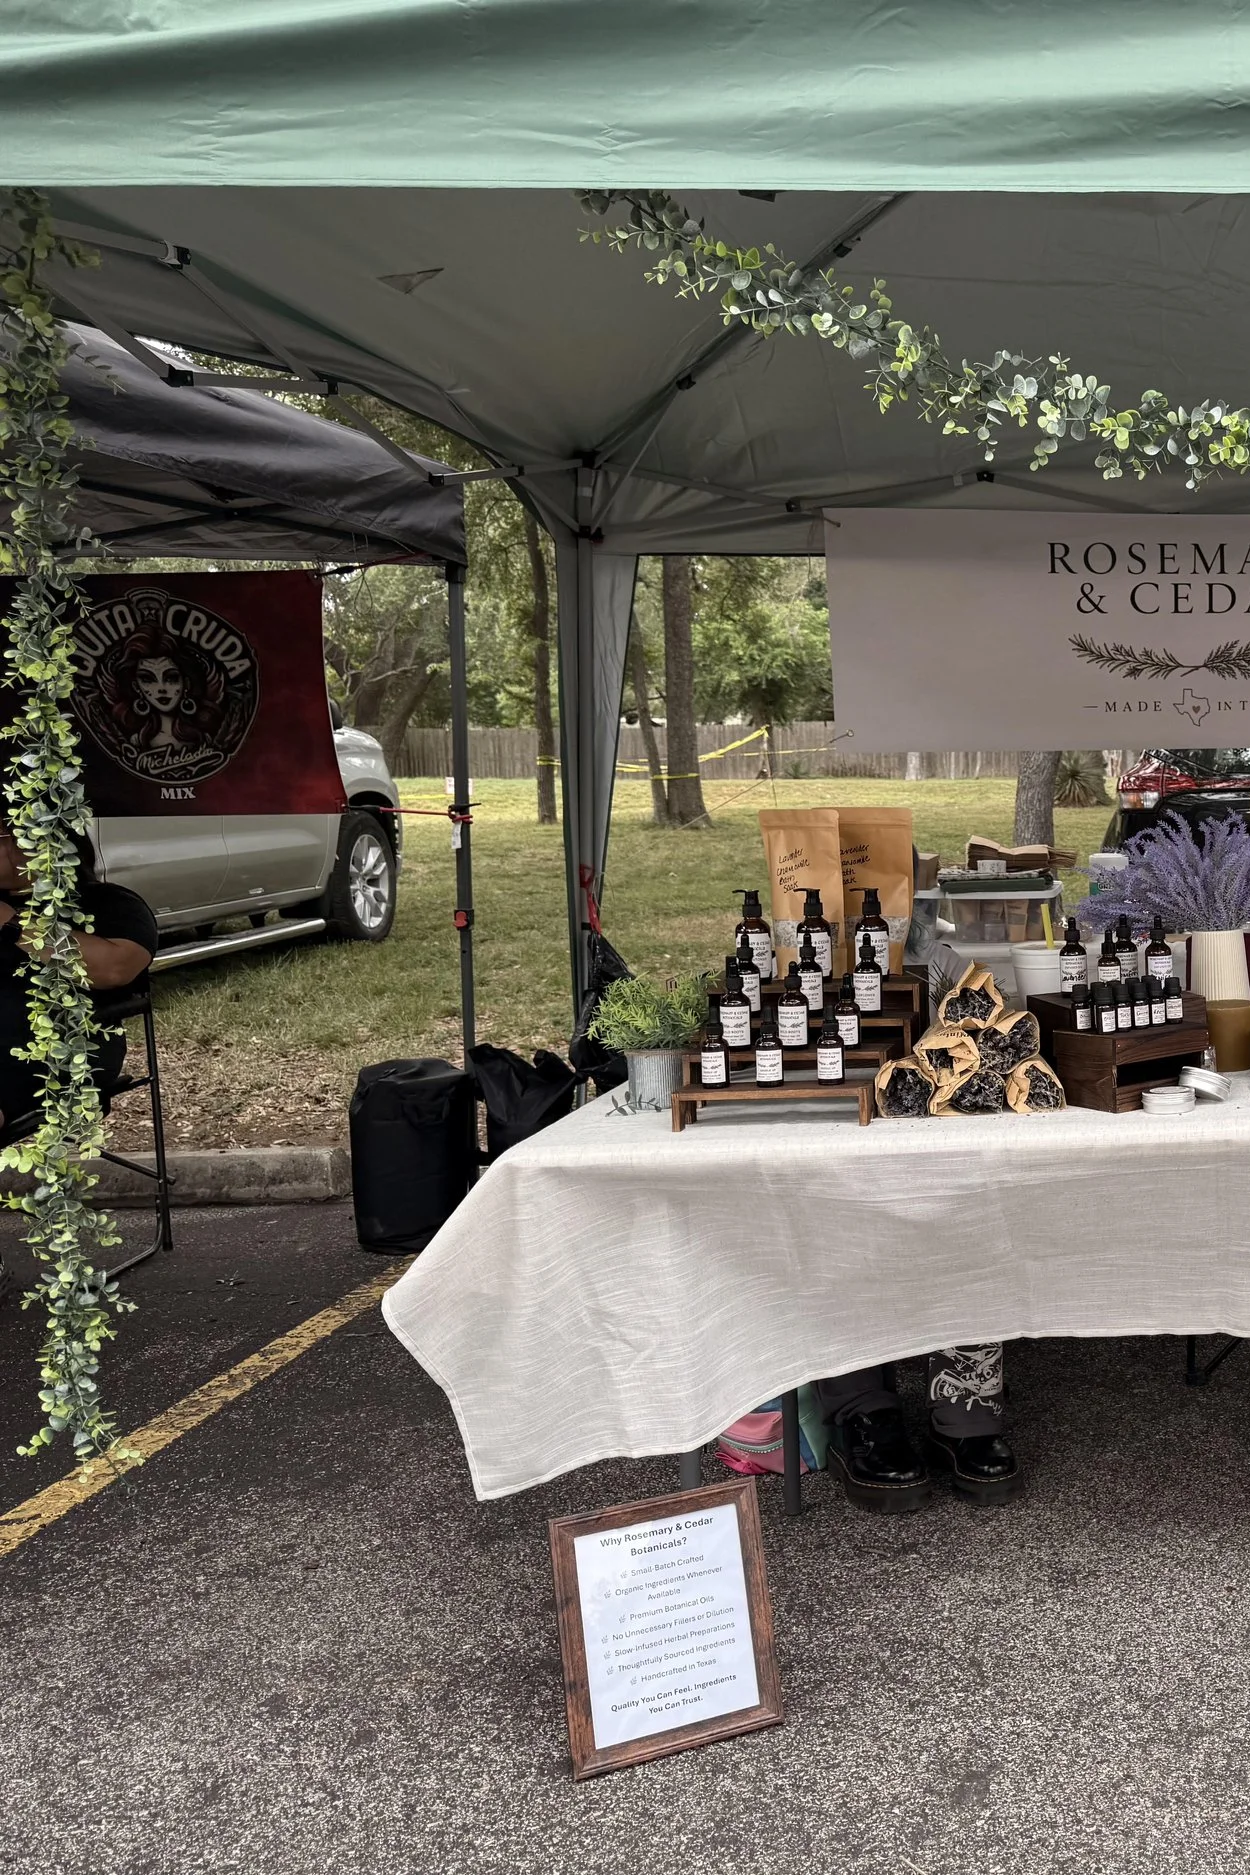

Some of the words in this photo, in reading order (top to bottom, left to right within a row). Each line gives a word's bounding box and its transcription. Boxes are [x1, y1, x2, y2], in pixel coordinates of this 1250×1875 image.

[1076, 582, 1109, 614] &
[166, 604, 252, 679] CRUDA
[1105, 701, 1162, 712] MADE
[1218, 701, 1232, 711] IN
[136, 742, 216, 772] Michelada
[160, 787, 197, 800] MIX
[600, 1536, 622, 1548] Why
[624, 1526, 673, 1542] Rosemary
[675, 1523, 683, 1531] &
[684, 1517, 714, 1529] Cedar
[630, 1537, 687, 1556] Botanicals?
[677, 1554, 704, 1566] Crafted
[615, 1583, 644, 1596] Organic
[645, 1574, 685, 1589] Ingredients
[686, 1566, 723, 1579] Whenever
[647, 1587, 681, 1601] Available
[629, 1608, 663, 1621] Premium
[664, 1599, 698, 1613] Botanical
[699, 1595, 714, 1604] Oils
[612, 1633, 623, 1641] No
[625, 1621, 673, 1638] Unnecessary
[674, 1615, 696, 1626] Fillers
[706, 1606, 734, 1619] Dilution
[614, 1639, 663, 1657] Slow-Infused
[664, 1632, 689, 1644] Herbal
[689, 1622, 735, 1638] Preparations
[618, 1655, 663, 1672] Thoughtfully
[663, 1647, 695, 1660] Sourced
[695, 1637, 736, 1652] Ingredients
[641, 1665, 687, 1682] Handcrafted
[697, 1658, 717, 1667] Texas
[611, 1699, 640, 1712] Quality
[640, 1695, 655, 1704] You
[656, 1690, 673, 1700] Can
[674, 1685, 693, 1695] Feel.
[694, 1674, 737, 1690] Ingredients
[648, 1706, 663, 1715] You
[665, 1701, 680, 1710] Can
[681, 1695, 703, 1706] Trust.
